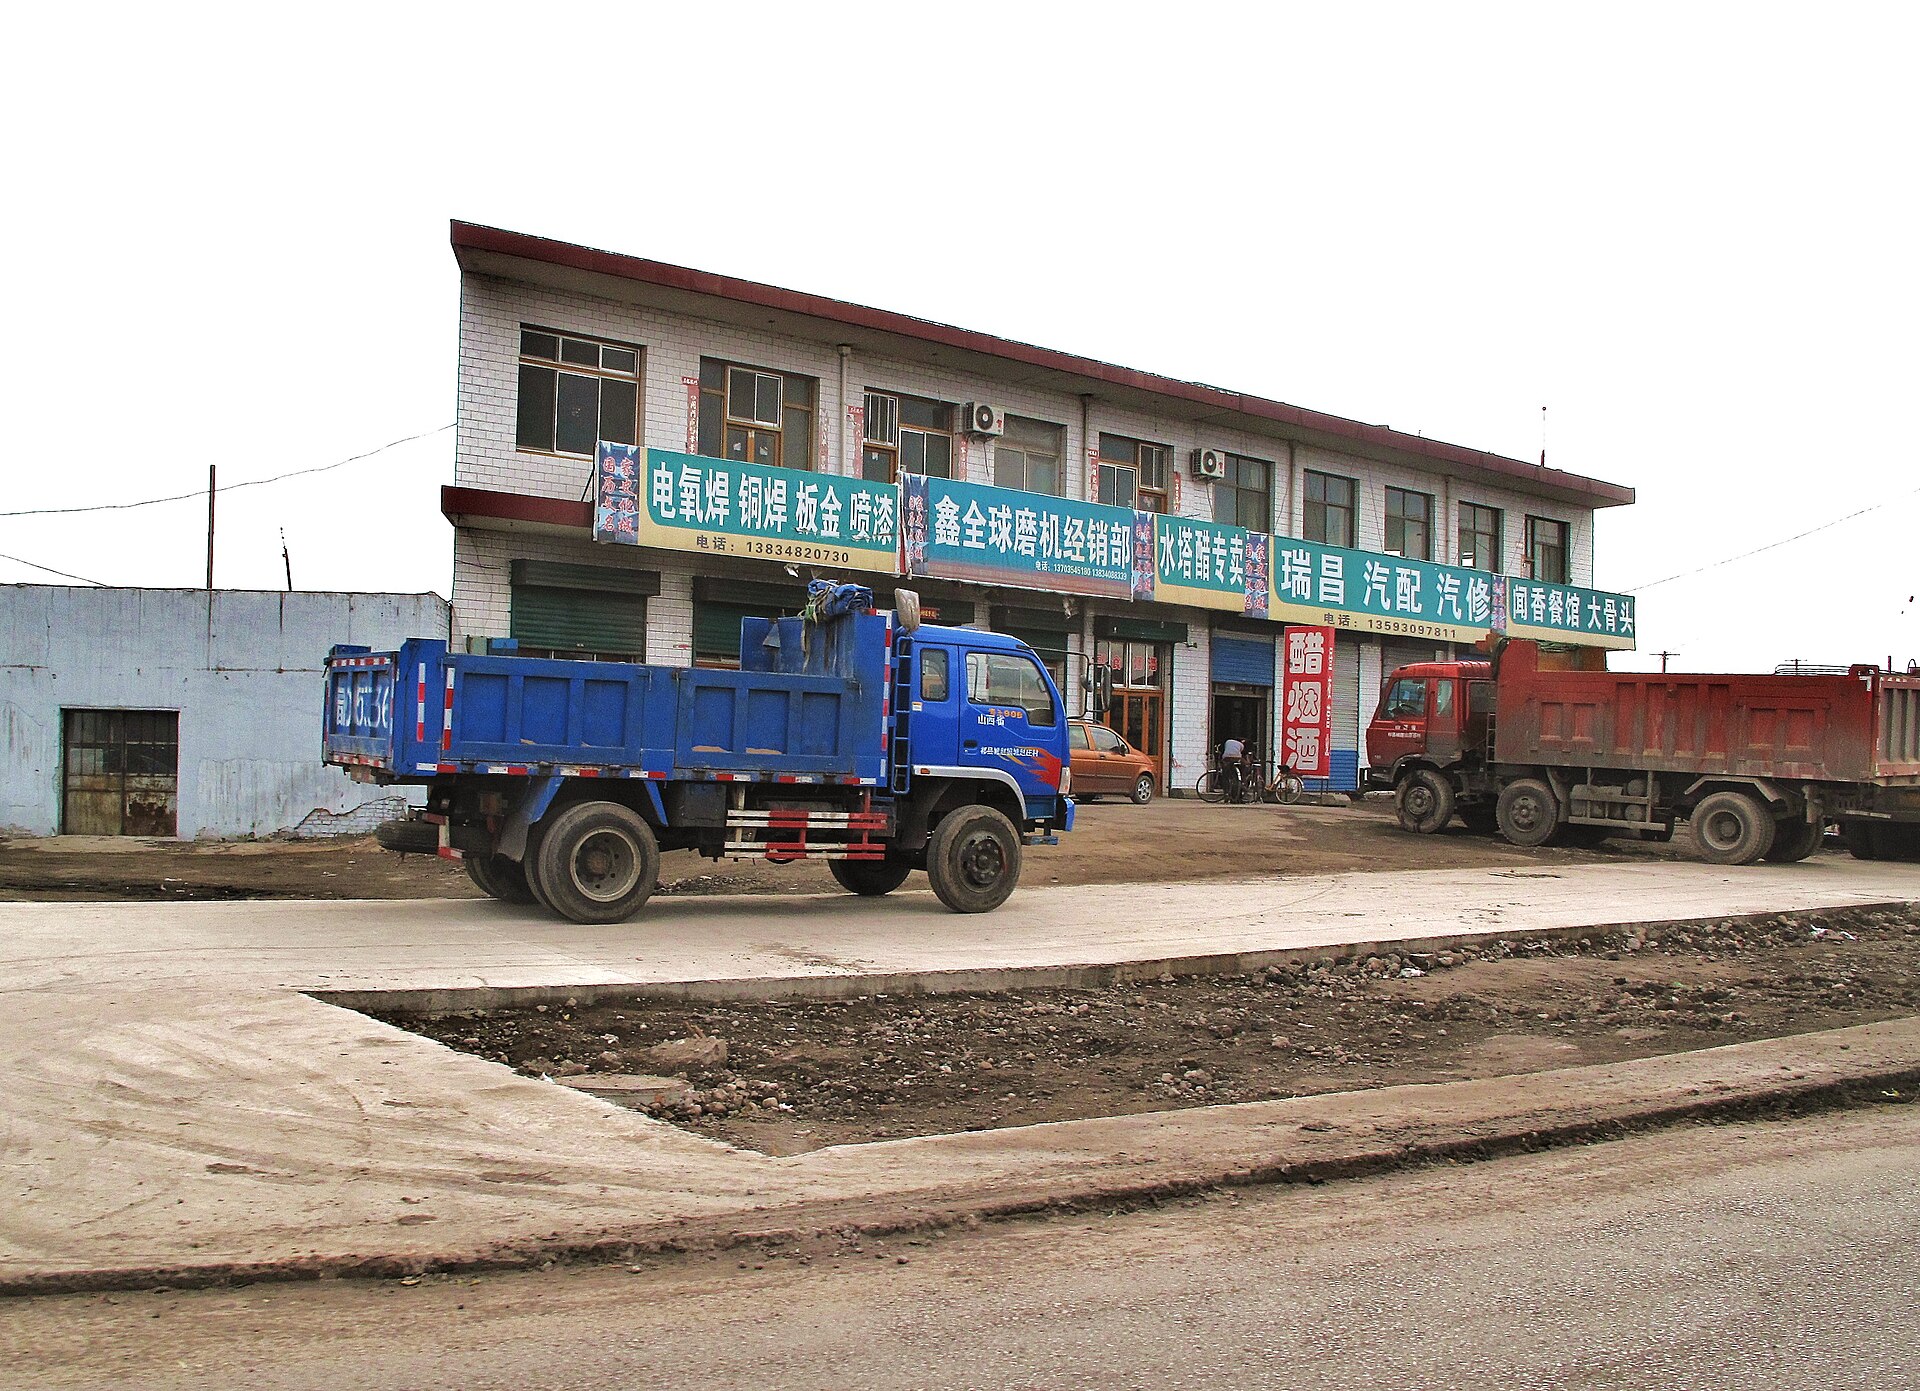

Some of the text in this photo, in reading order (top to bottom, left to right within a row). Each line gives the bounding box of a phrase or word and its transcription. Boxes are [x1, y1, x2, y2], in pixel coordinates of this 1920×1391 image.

[603, 456, 635, 476] 国家
[601, 475, 637, 497] 历史
[601, 496, 635, 513] 文化
[652, 461, 895, 546] 电氧焊 铜焊 板金 喷漆
[604, 515, 635, 536] 名城
[934, 494, 1132, 570] 鑫全球磨机经销部
[696, 534, 850, 563] 电话： 13834820730
[1159, 523, 1244, 586] 水塔醋专卖
[1280, 548, 1345, 605] 瑞昌
[1362, 560, 1422, 614] 汽配
[1436, 572, 1491, 622] 汽修
[1512, 584, 1580, 628] 闻香餐馆
[1587, 596, 1634, 634] 大骨头
[1323, 612, 1457, 639] 电话： 13593097811
[1286, 631, 1325, 771] 醋烟酒
[977, 713, 1006, 726] 山西省
